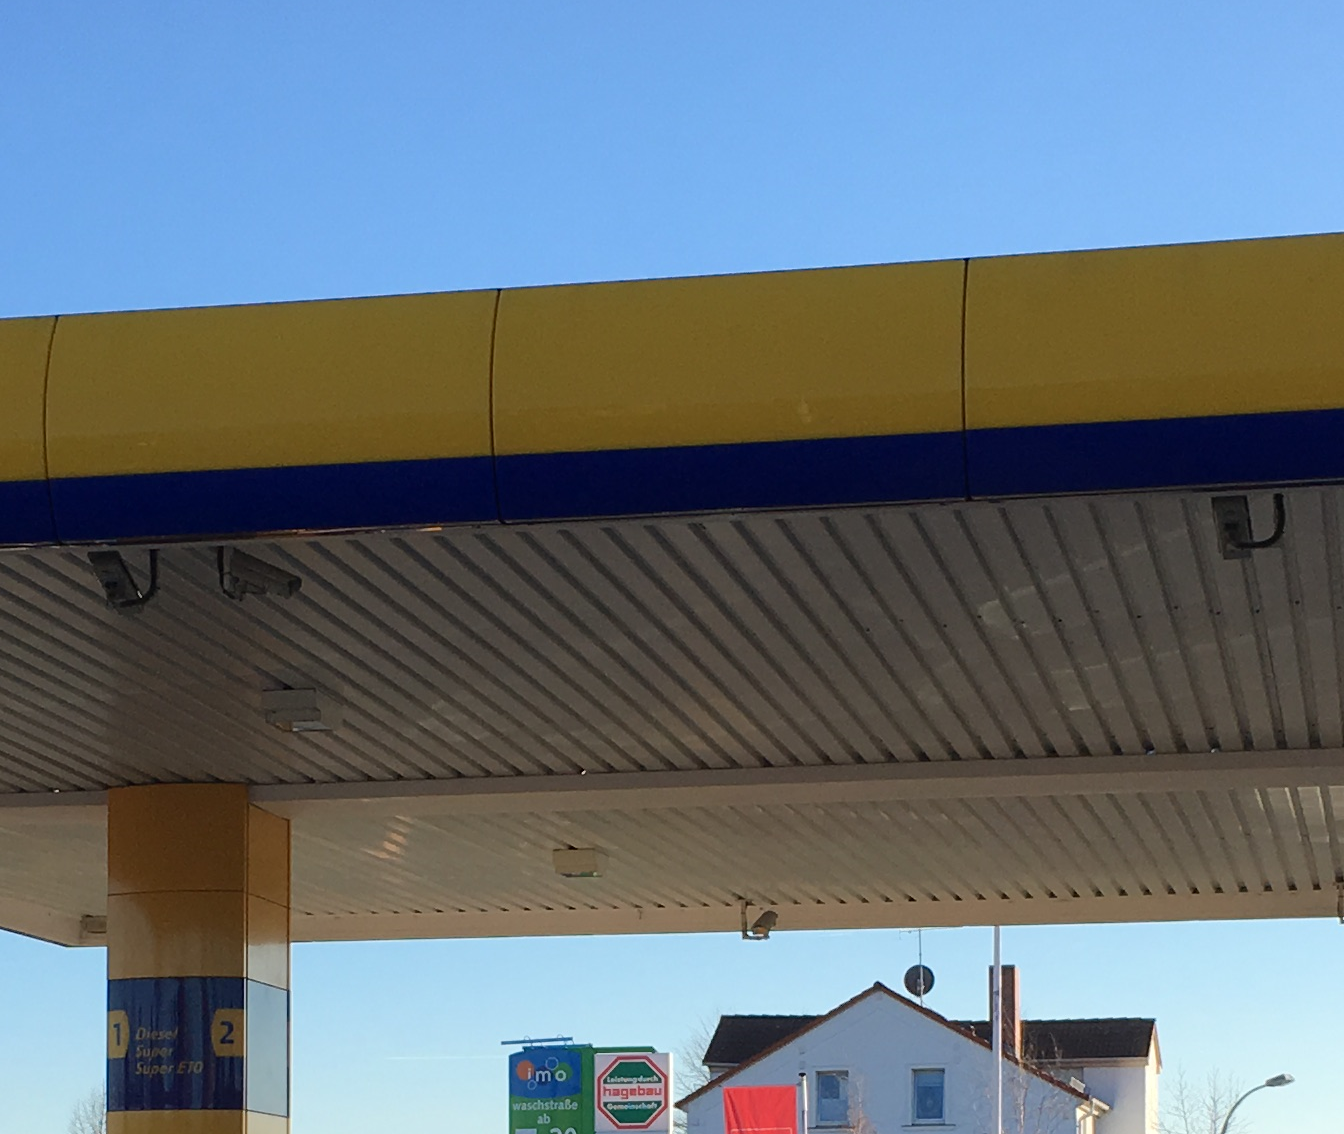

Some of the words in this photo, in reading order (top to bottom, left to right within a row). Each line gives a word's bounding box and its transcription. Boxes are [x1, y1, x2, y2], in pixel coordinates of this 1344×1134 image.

[113, 1022, 121, 1046] 1
[136, 1026, 178, 1040] Diesel
[219, 1020, 235, 1045] 2
[135, 1045, 174, 1061] Super
[135, 1061, 174, 1078] Super
[526, 1067, 567, 1082] imo
[603, 1085, 662, 1099] hagebau
[512, 1099, 579, 1112] waschstraße
[537, 1114, 551, 1125] ab
